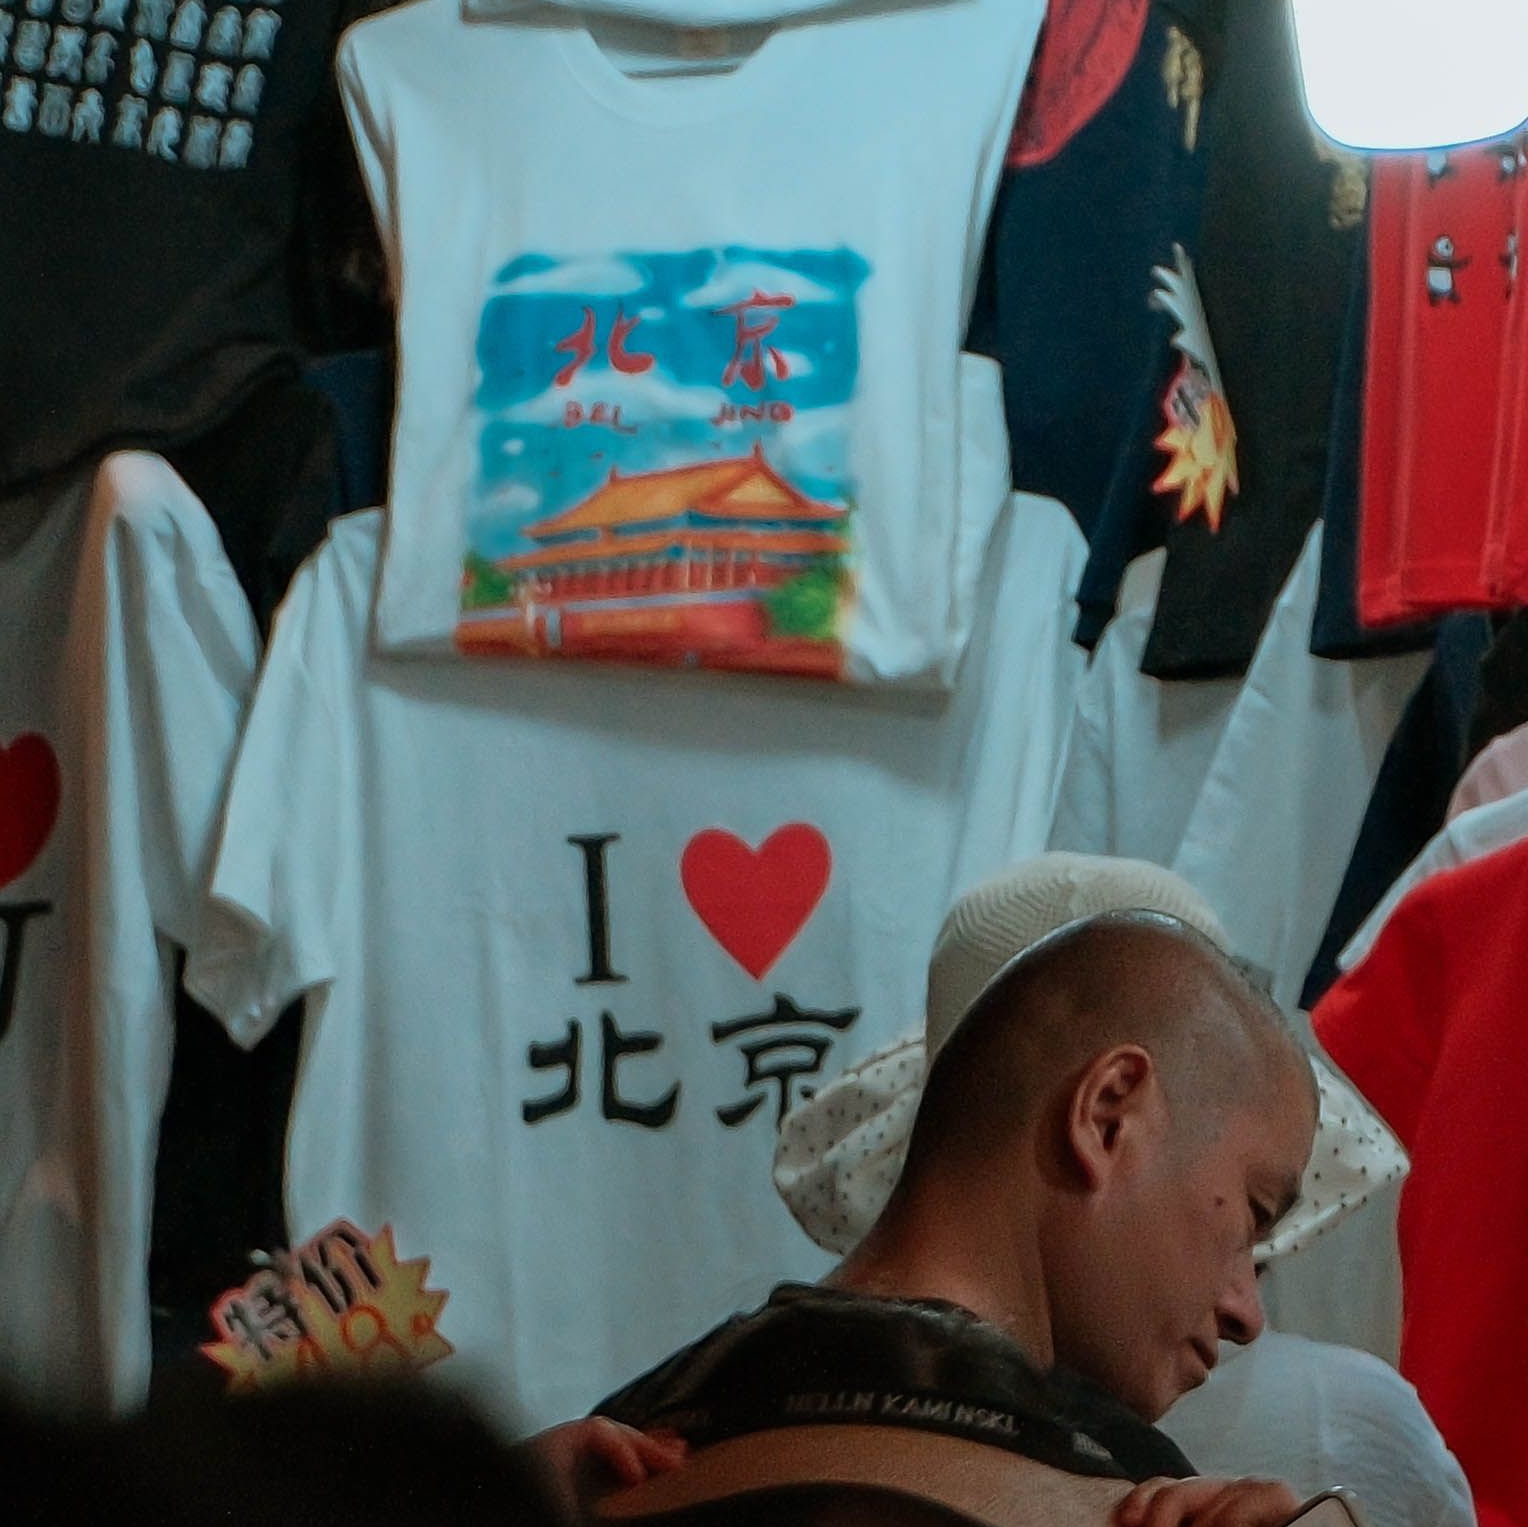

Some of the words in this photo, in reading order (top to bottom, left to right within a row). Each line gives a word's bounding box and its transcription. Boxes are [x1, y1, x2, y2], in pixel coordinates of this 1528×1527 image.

[554, 289, 797, 392] 北京
[567, 833, 630, 985] I
[523, 992, 863, 1134] 北京
